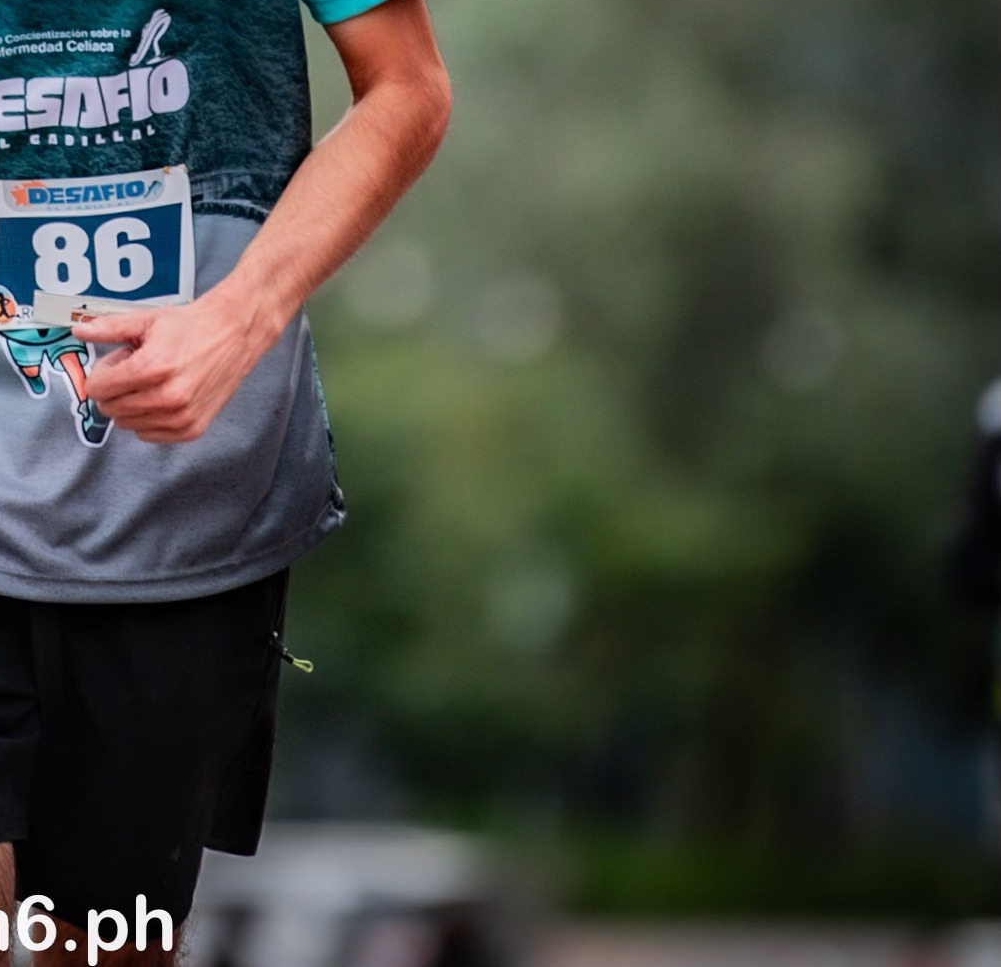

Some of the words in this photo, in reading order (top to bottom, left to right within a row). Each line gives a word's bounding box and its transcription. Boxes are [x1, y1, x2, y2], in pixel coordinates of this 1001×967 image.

[90, 27, 119, 39] sobre
[121, 27, 132, 38] la
[29, 124, 155, 147] CADILLAL
[27, 180, 145, 205] DESAFIO
[32, 217, 154, 296] 86
